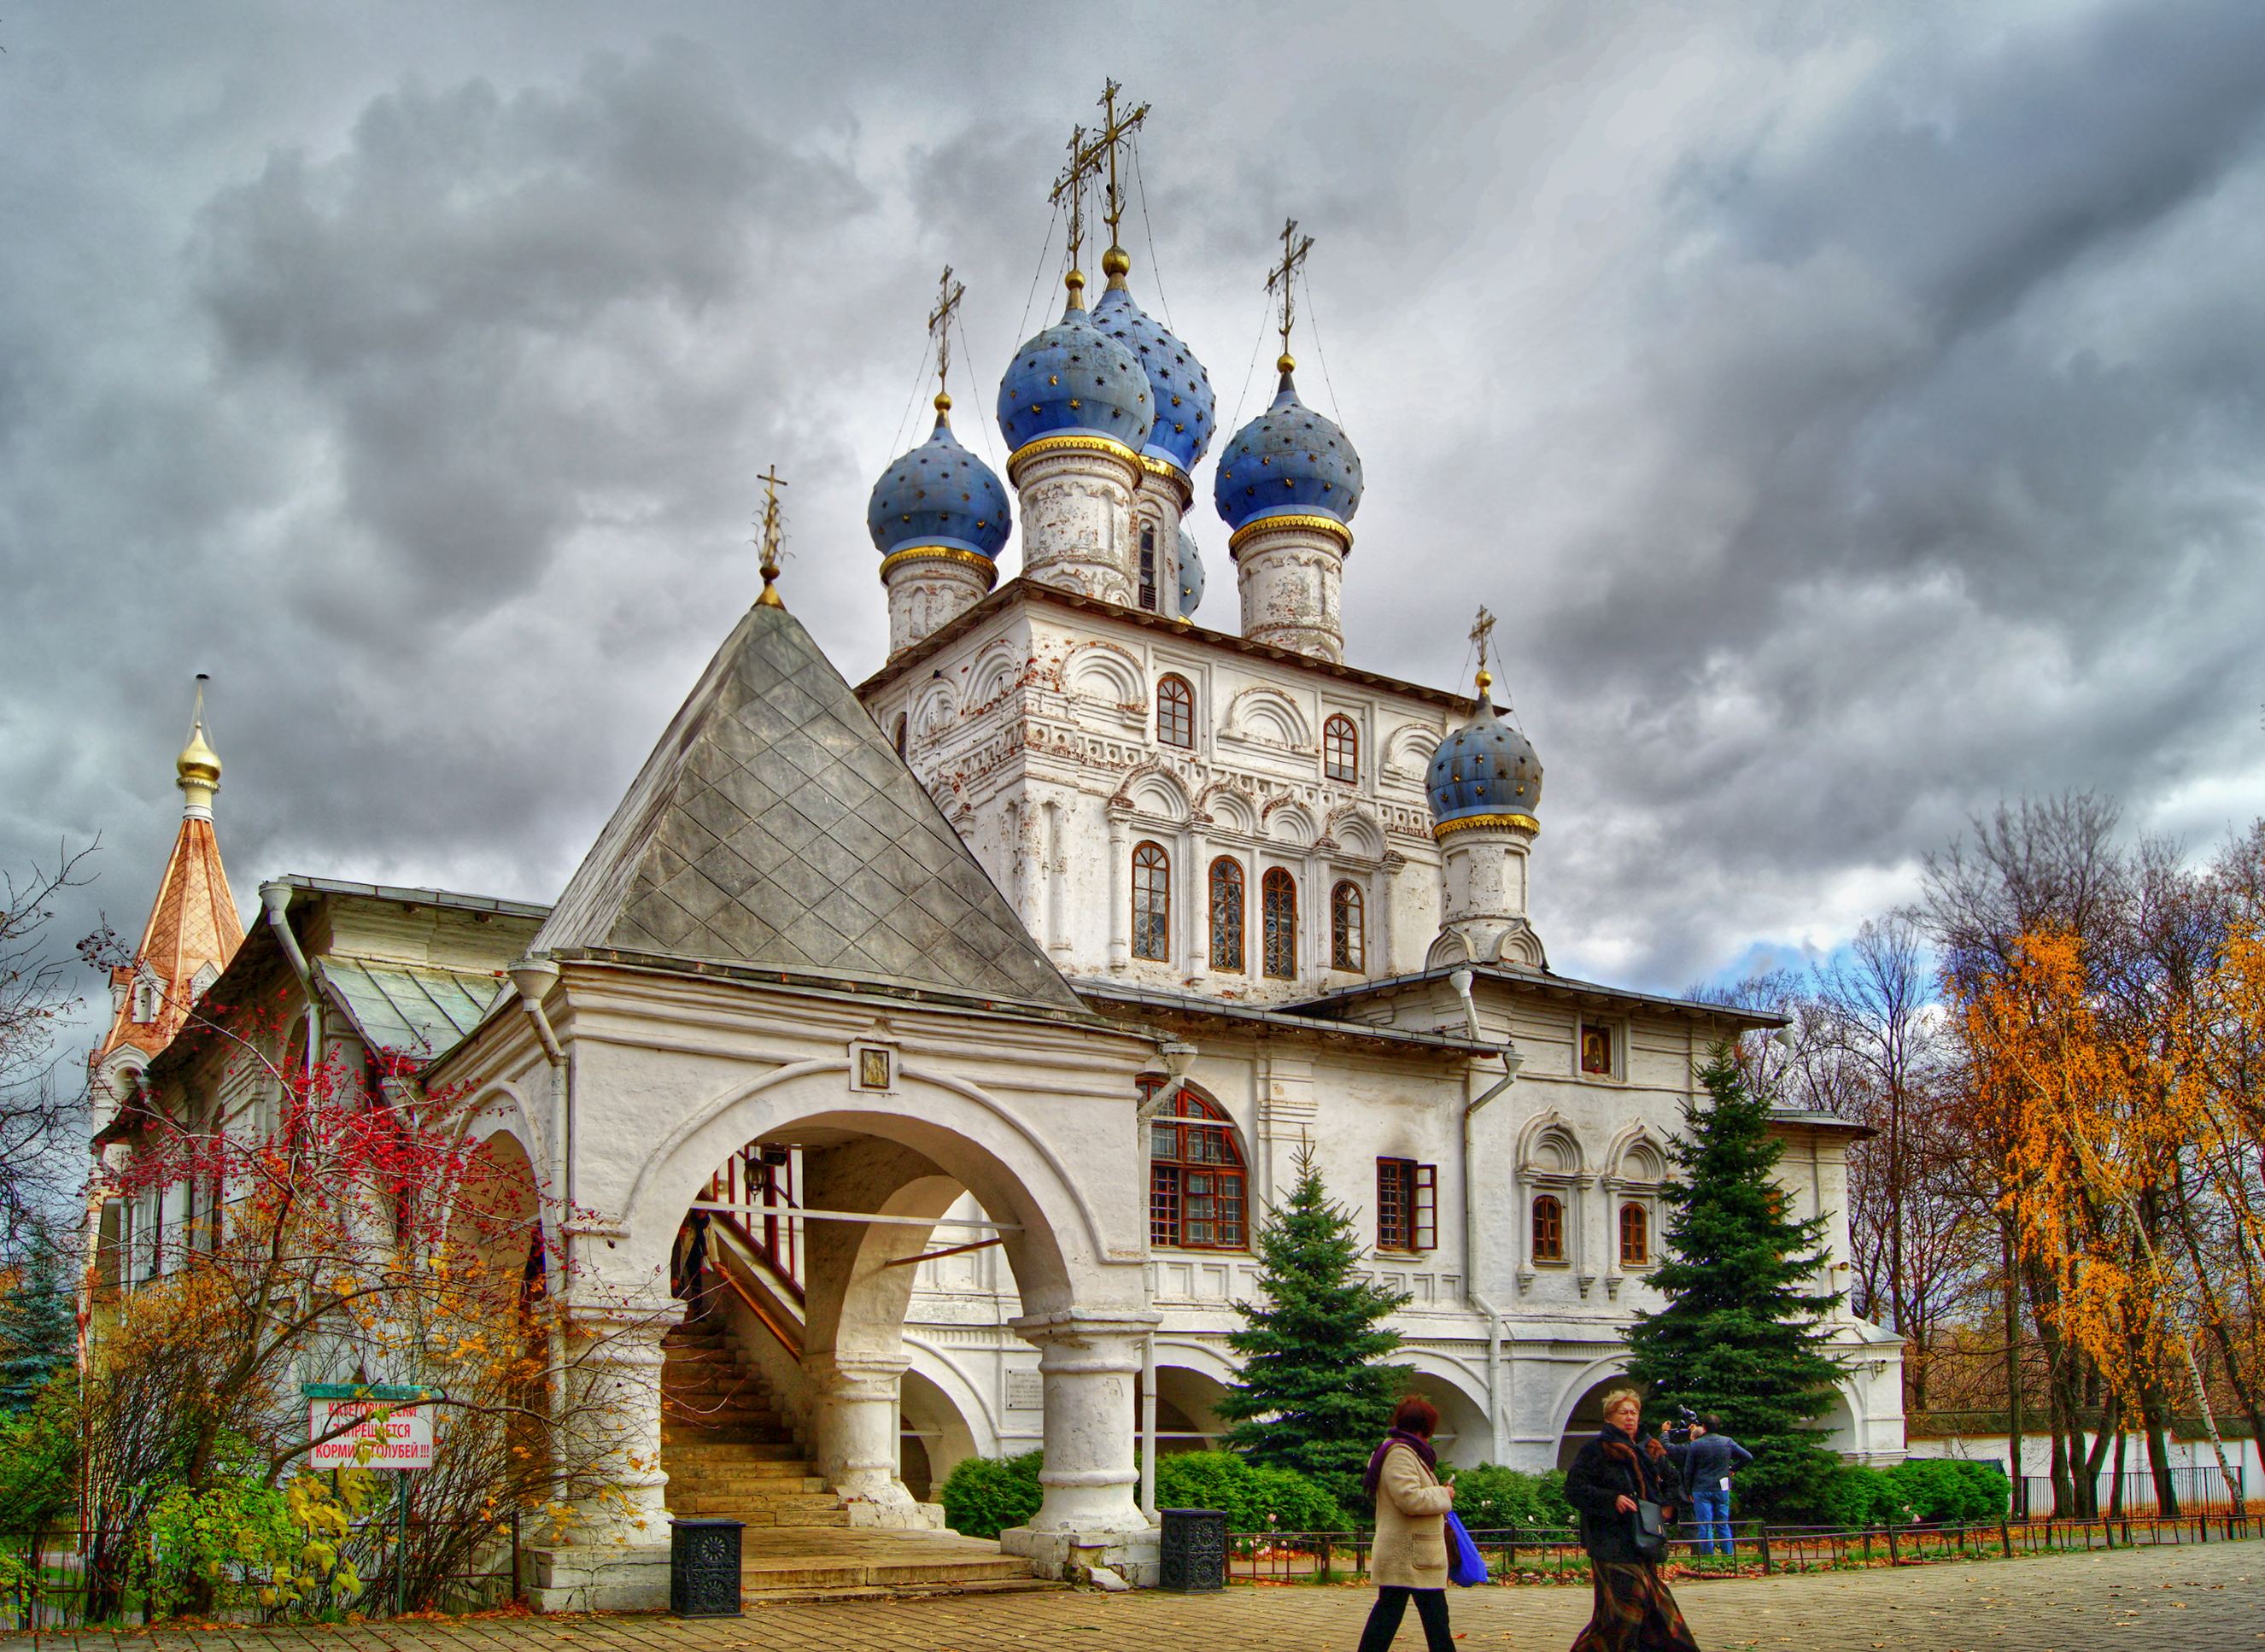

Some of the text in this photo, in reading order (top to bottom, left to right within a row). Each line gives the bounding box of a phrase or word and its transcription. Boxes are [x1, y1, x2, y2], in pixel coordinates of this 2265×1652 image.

[332, 1423, 410, 1438] ПРЕЩЕТСЯ
[316, 1443, 371, 1458] КОРМИ
[372, 1442, 418, 1458] ГОЛУБЕЙ
